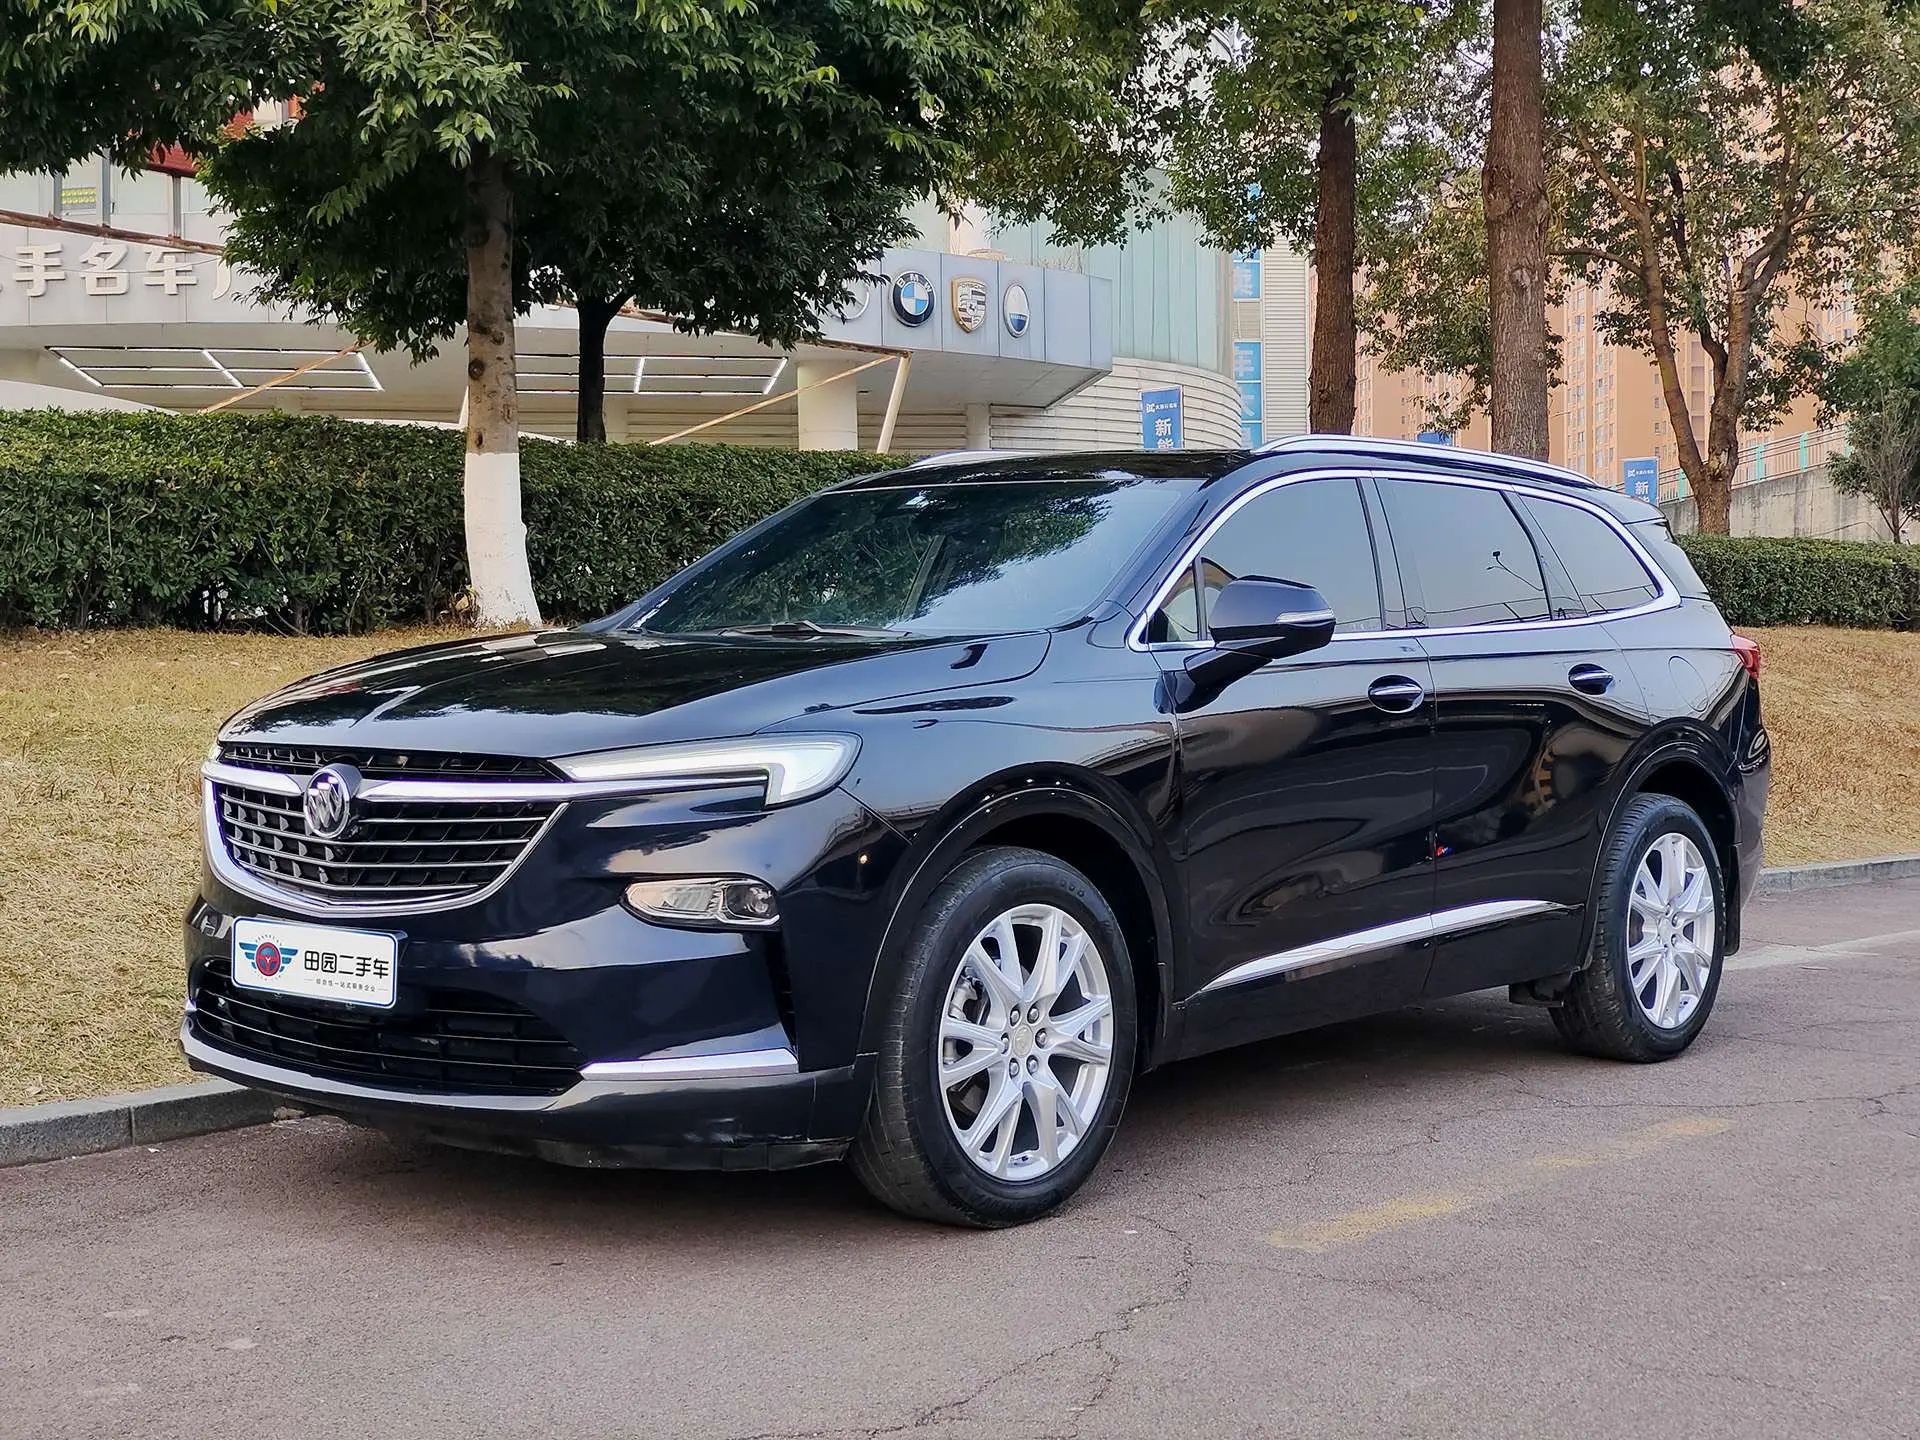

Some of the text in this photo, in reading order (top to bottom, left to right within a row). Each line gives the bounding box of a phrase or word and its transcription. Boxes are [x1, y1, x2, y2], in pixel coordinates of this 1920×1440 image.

[14, 243, 233, 300] 手名车
[896, 273, 934, 294] BMW
[304, 950, 390, 980] 田园二手车
